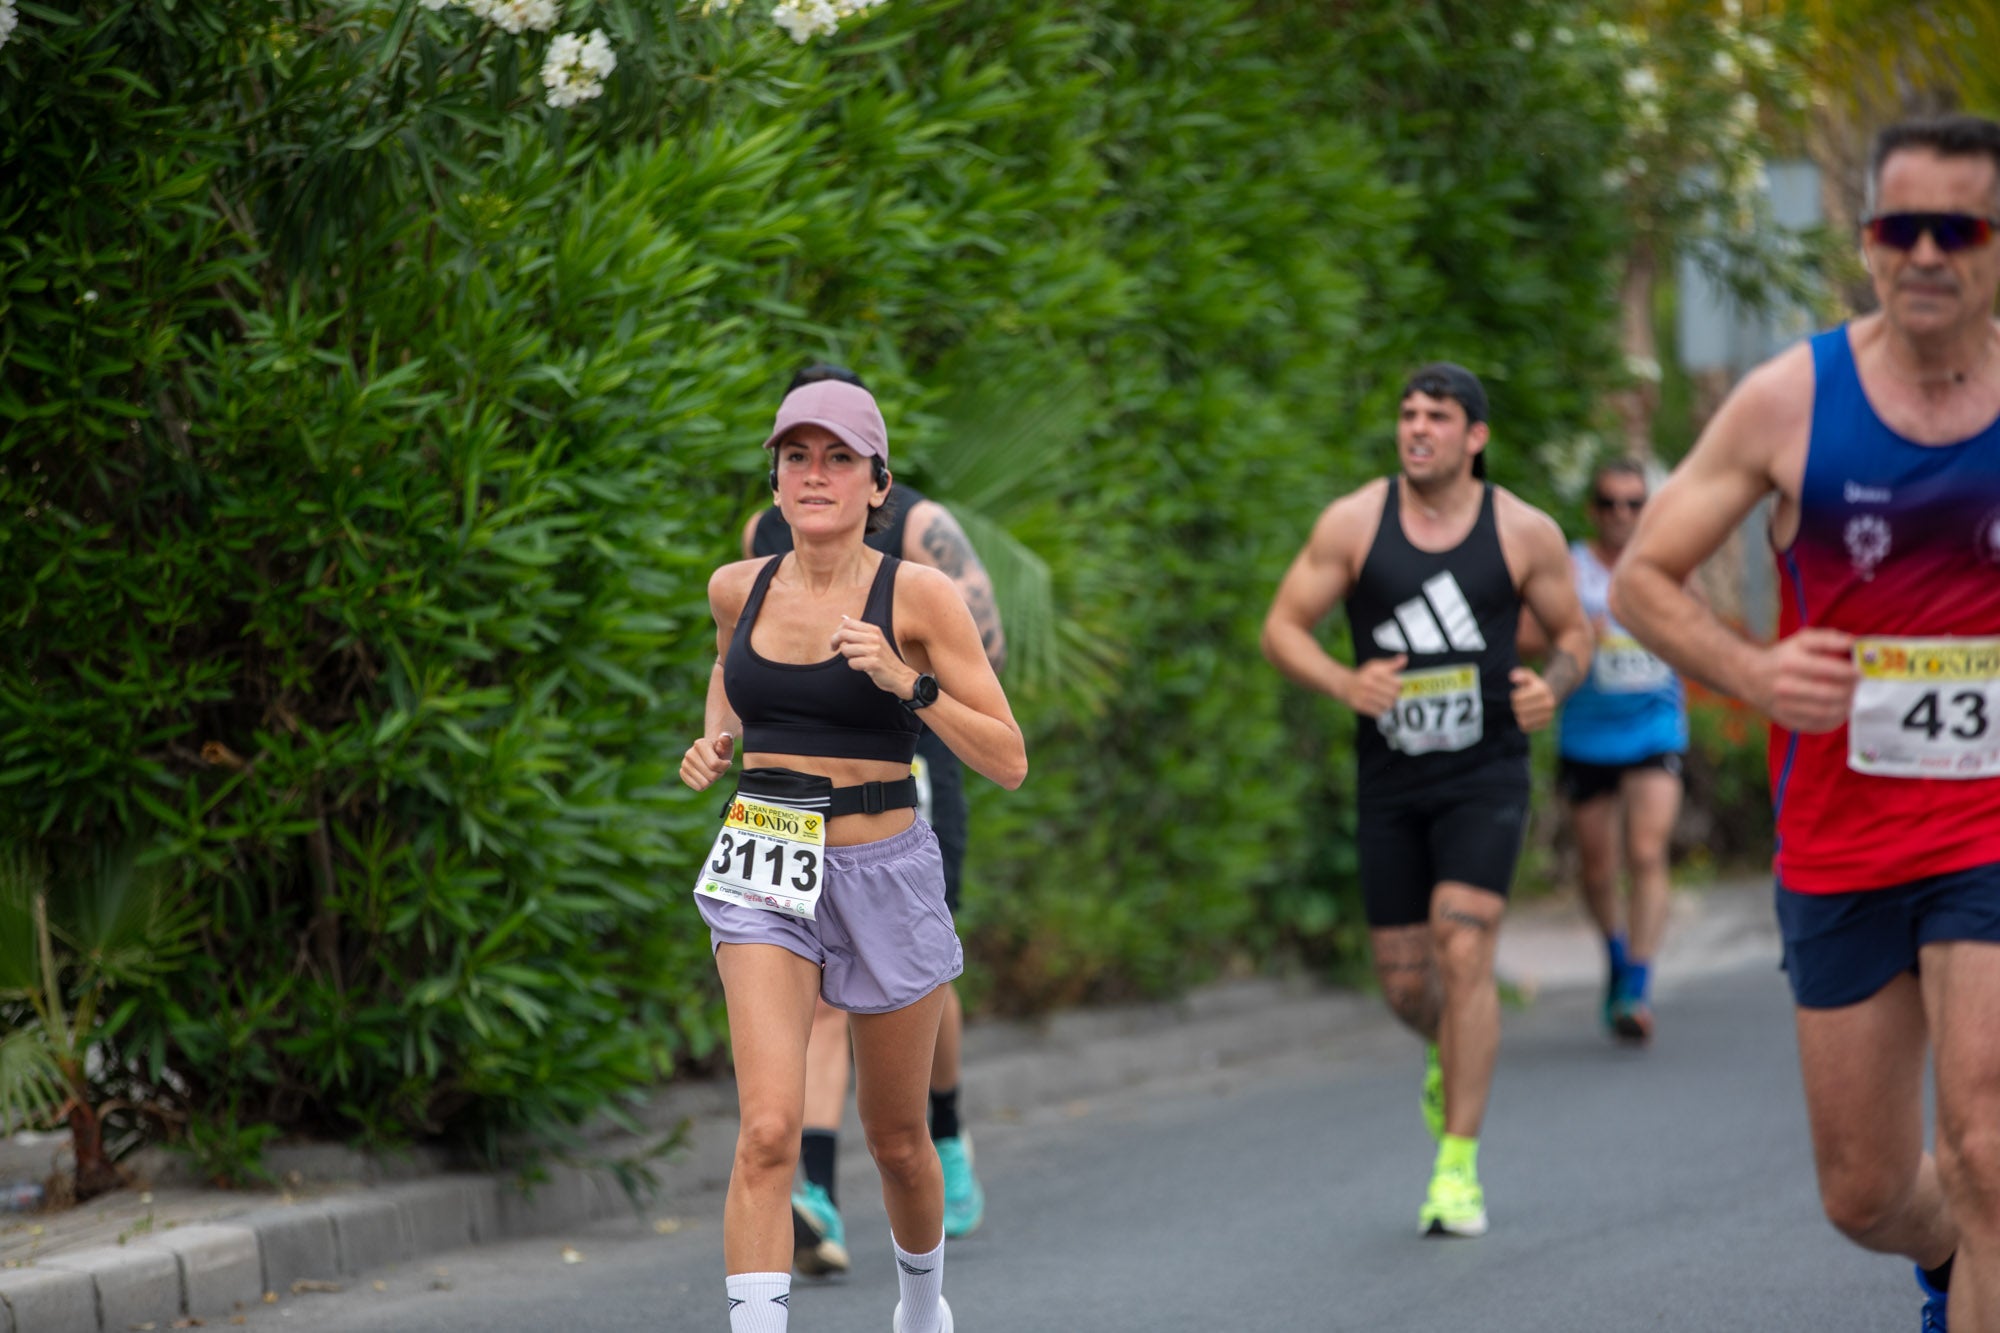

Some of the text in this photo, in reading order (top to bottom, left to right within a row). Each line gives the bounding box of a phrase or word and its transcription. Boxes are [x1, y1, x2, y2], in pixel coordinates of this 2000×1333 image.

[1902, 688, 1988, 741] 43
[744, 811, 798, 834] FONDO
[748, 804, 767, 815] GRAN
[769, 809, 795, 820] PREMIO
[712, 833, 817, 892] 3113
